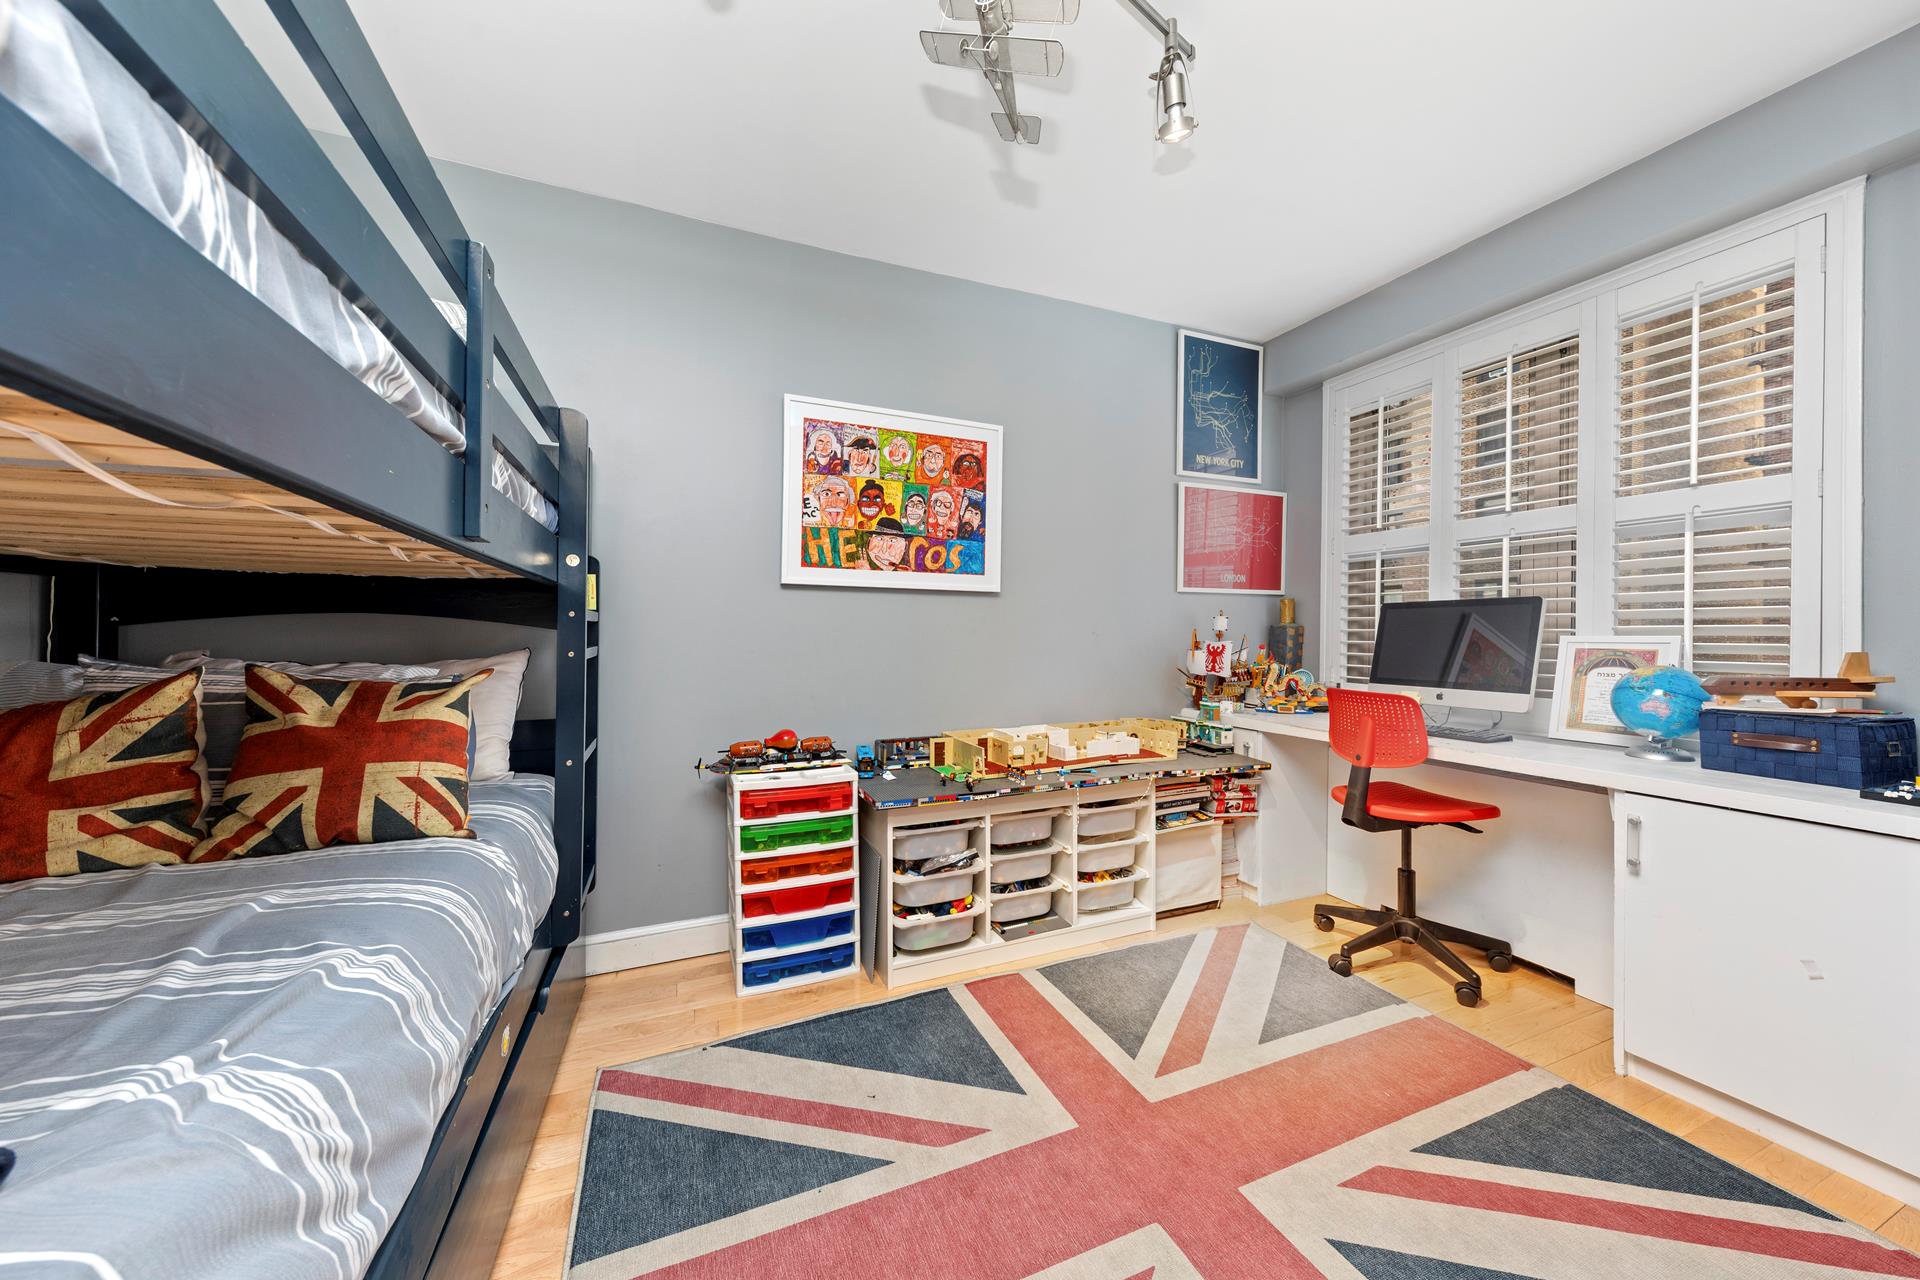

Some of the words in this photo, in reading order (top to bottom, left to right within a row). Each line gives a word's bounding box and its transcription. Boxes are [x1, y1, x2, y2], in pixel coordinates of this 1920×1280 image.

[1196, 454, 1211, 465] NEW
[1212, 456, 1230, 467] YORK
[1230, 458, 1244, 469] CITY
[1221, 574, 1246, 583] LONDON
